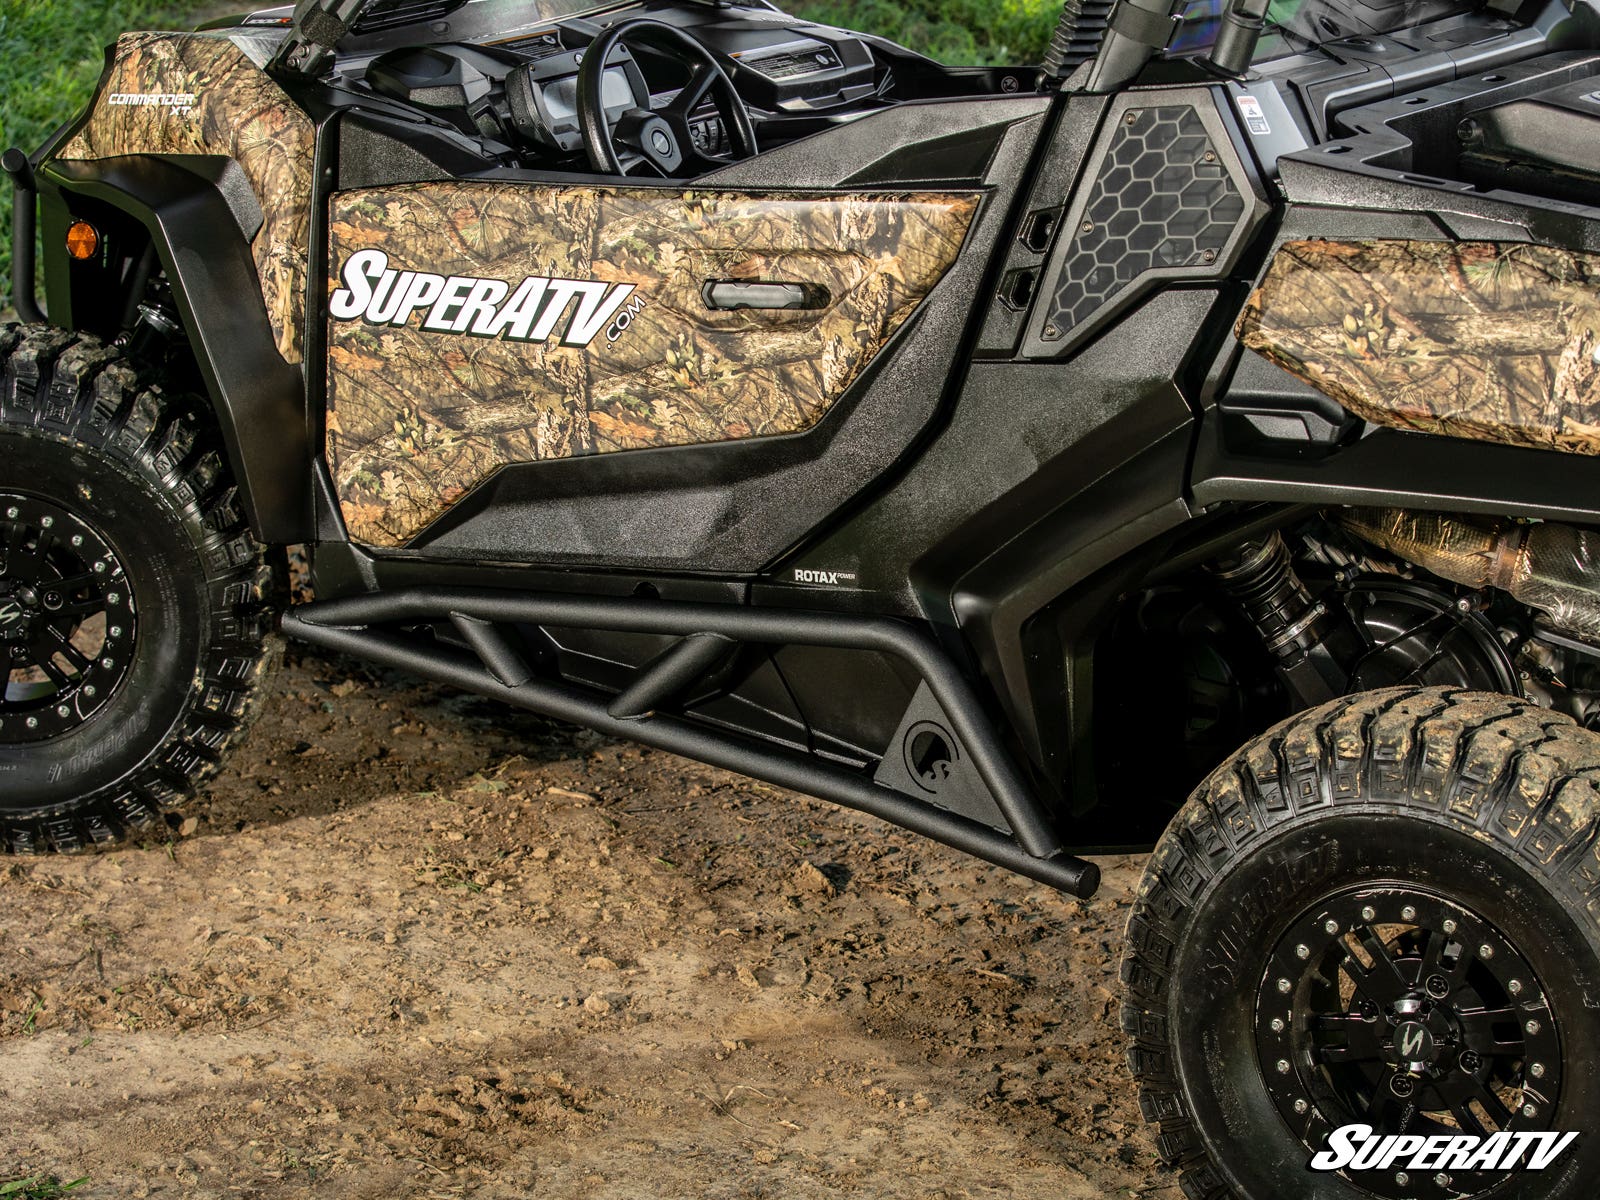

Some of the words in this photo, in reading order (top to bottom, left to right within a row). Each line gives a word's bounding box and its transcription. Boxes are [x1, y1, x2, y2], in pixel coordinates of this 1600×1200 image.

[108, 93, 195, 105] COMMANDER
[169, 105, 192, 116] XT
[328, 247, 638, 348] SUPERATV
[794, 569, 838, 584] ROTAX
[837, 572, 856, 580] POWER
